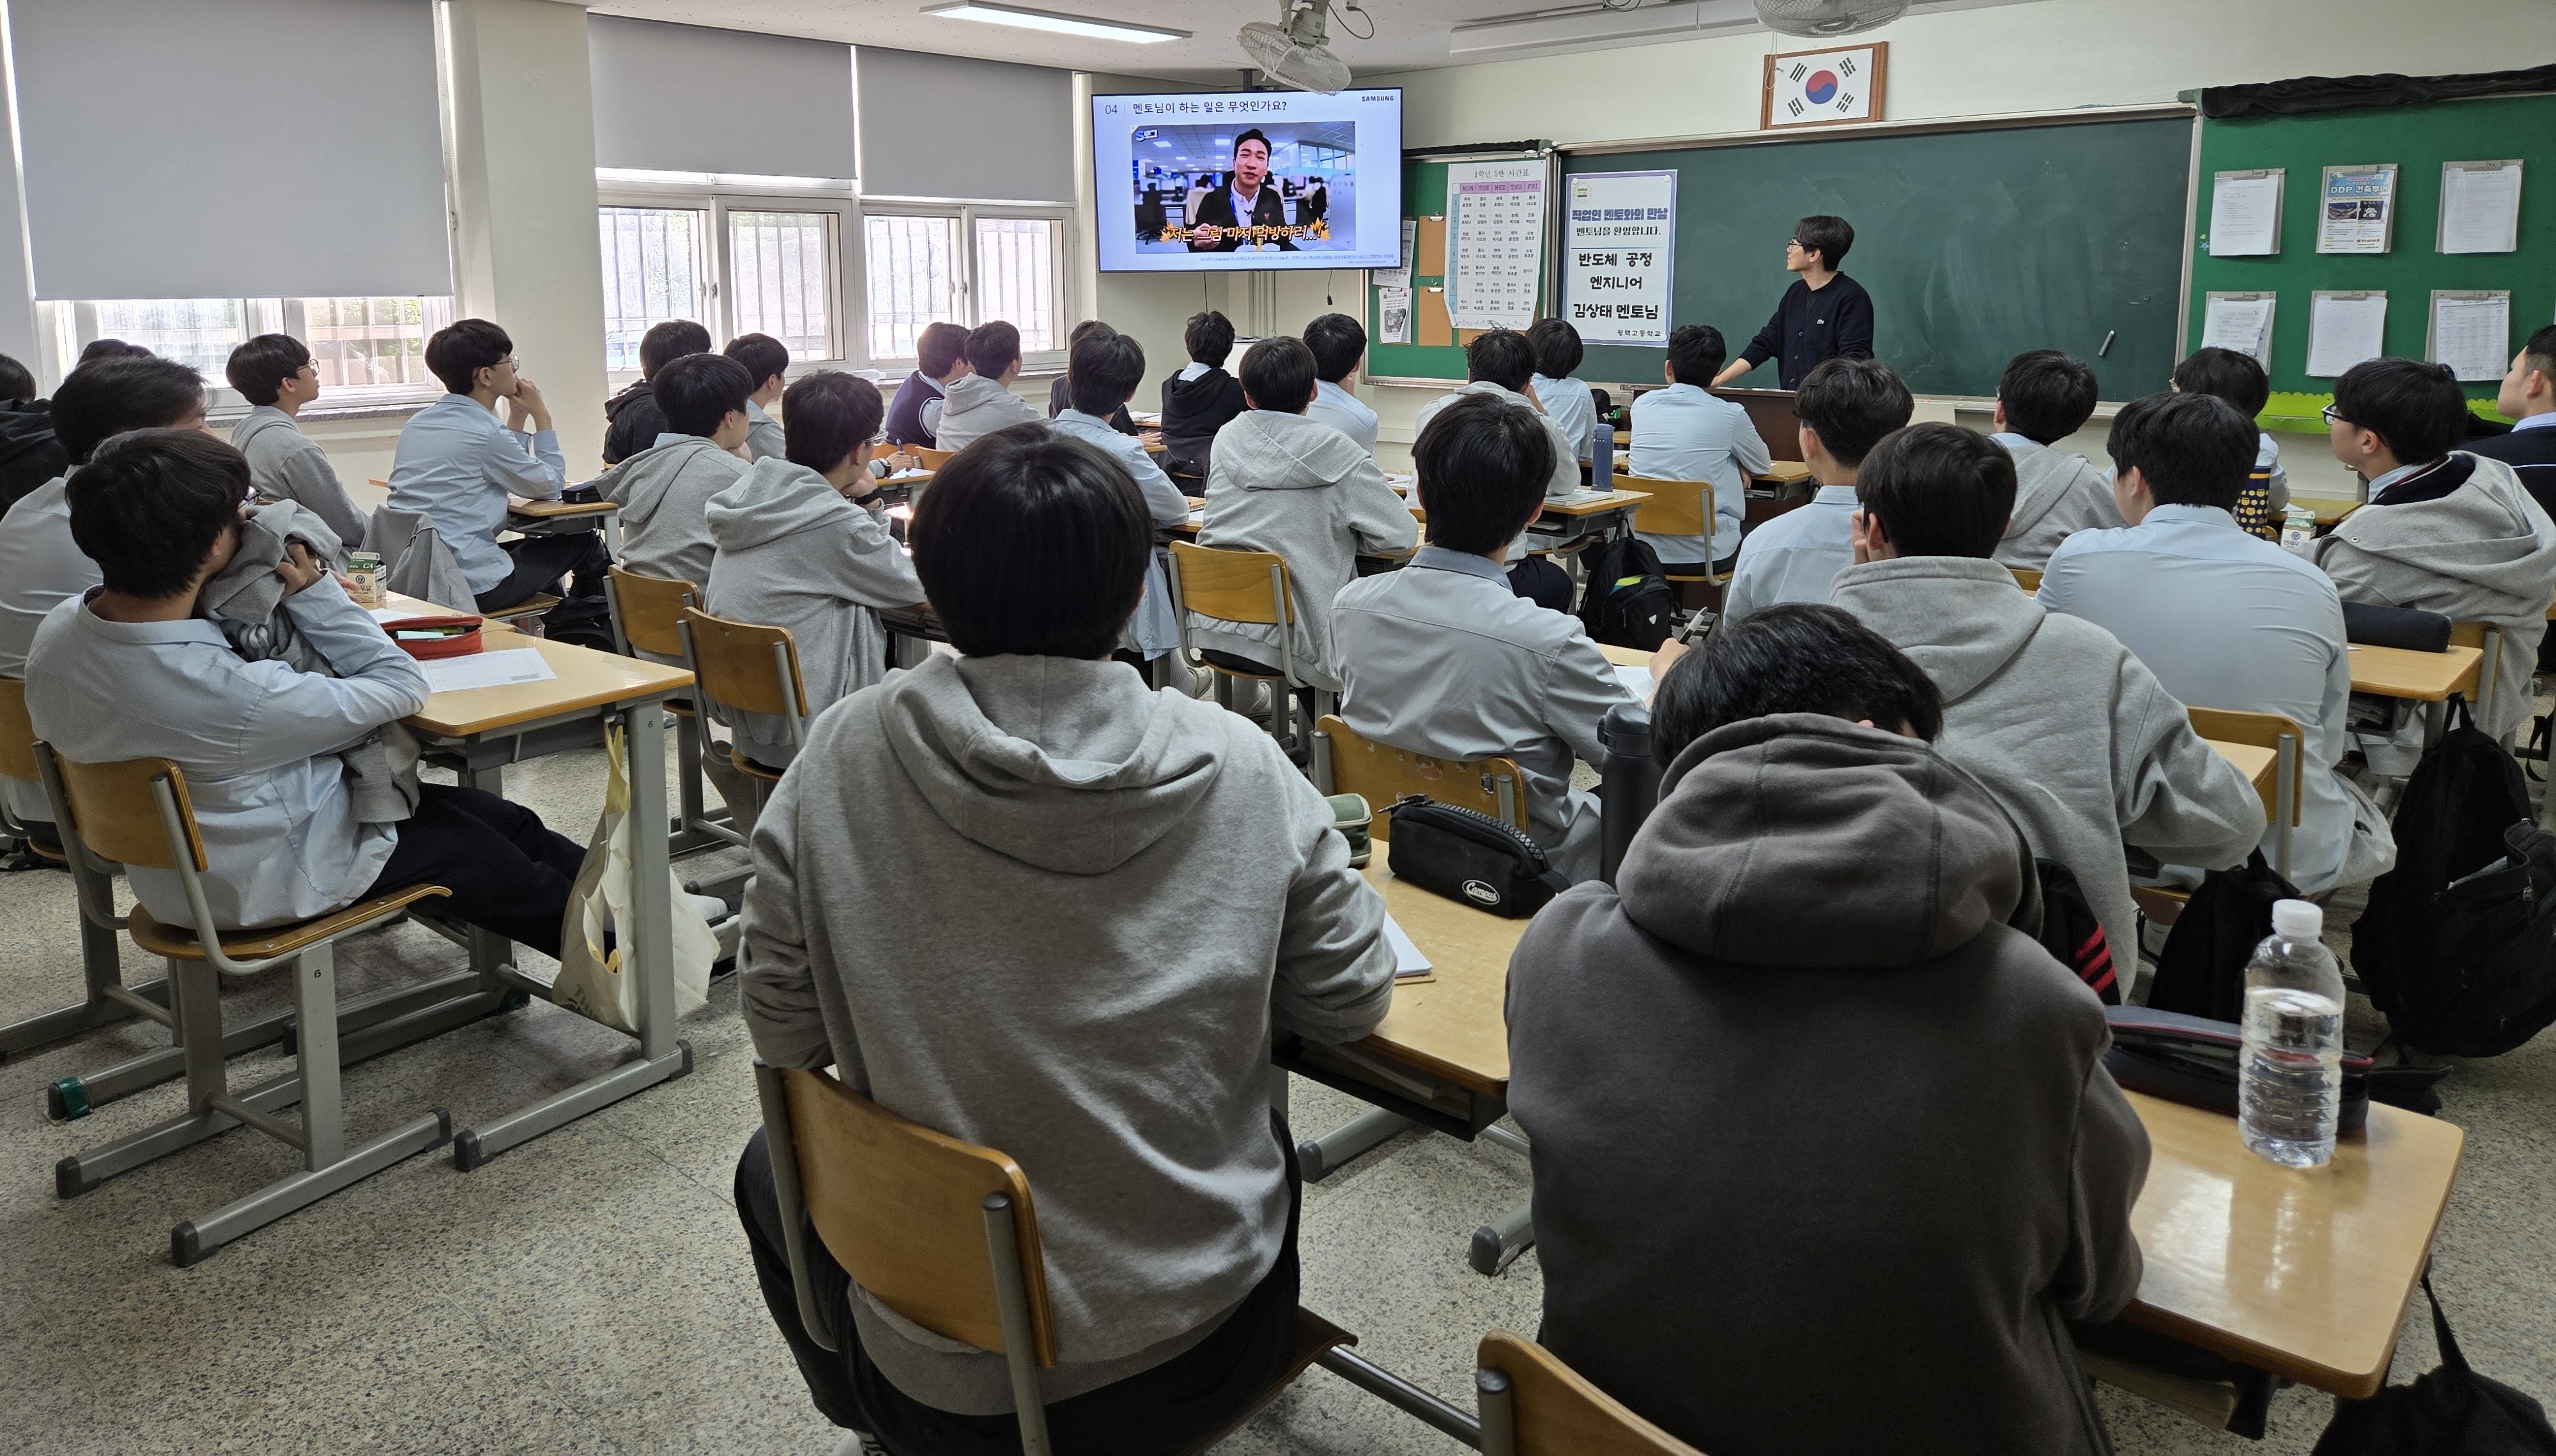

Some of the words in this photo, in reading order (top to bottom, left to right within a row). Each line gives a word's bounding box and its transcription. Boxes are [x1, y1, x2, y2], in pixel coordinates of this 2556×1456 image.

[1105, 104, 1118, 114] 04
[1133, 103, 1174, 114] 멘토님이
[1179, 102, 1199, 114] 하는
[1203, 102, 1224, 113] 일은
[1228, 100, 1287, 112] 무엇인가요?
[1509, 169, 1529, 177] 시간표
[1572, 209, 1601, 222] 직업인
[1604, 208, 1644, 221] 멘토와의
[1647, 208, 1668, 220] 만남
[1169, 227, 1194, 242] 저는
[1197, 226, 1222, 241] 그럼
[1576, 227, 1611, 236] 멘토님을
[1613, 226, 1661, 236] 환영합니다.
[1578, 253, 1617, 267] 반도체
[1626, 252, 1652, 267] 공정
[1590, 275, 1642, 290] 엔지니어
[1573, 303, 1612, 318] 김상태
[1616, 304, 1658, 319] 멘토님
[648, 720, 654, 728] 6
[1466, 882, 1497, 902] Campus
